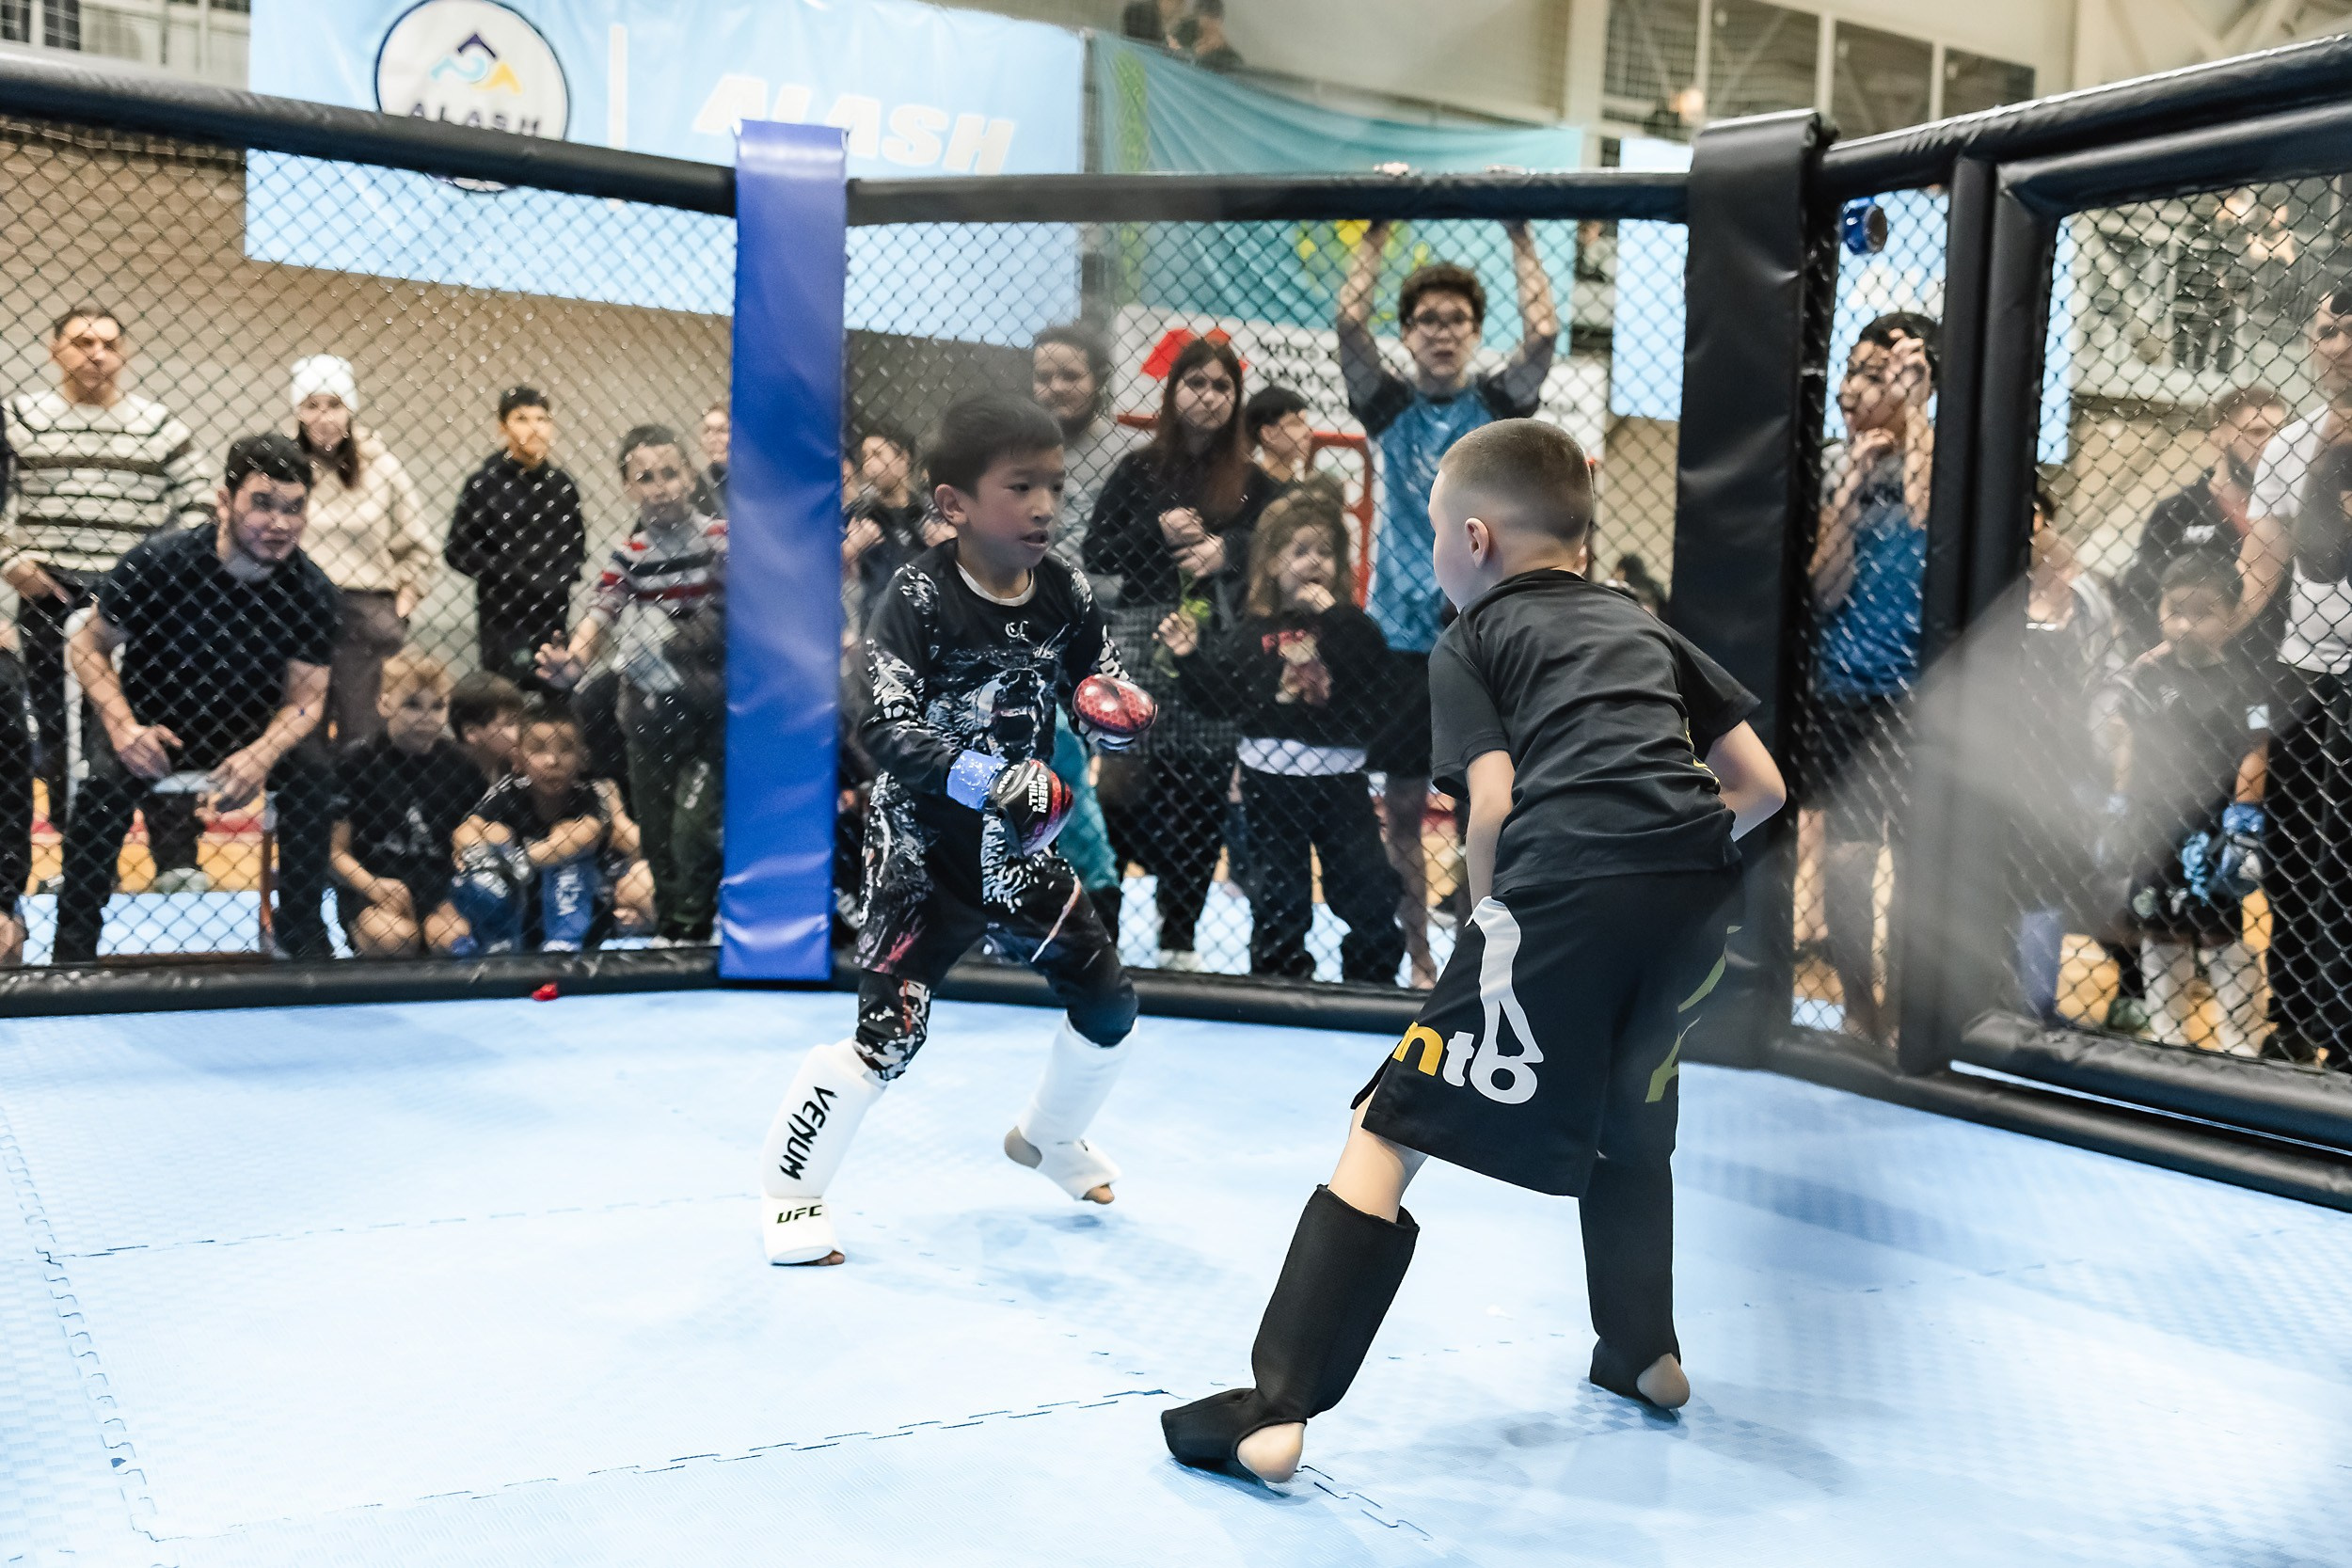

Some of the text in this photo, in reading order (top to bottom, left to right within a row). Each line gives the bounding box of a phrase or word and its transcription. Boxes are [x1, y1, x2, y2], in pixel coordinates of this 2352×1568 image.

[1037, 773, 1048, 814] GREEN
[779, 1085, 838, 1180] VENUM
[776, 1204, 823, 1224] UFC
